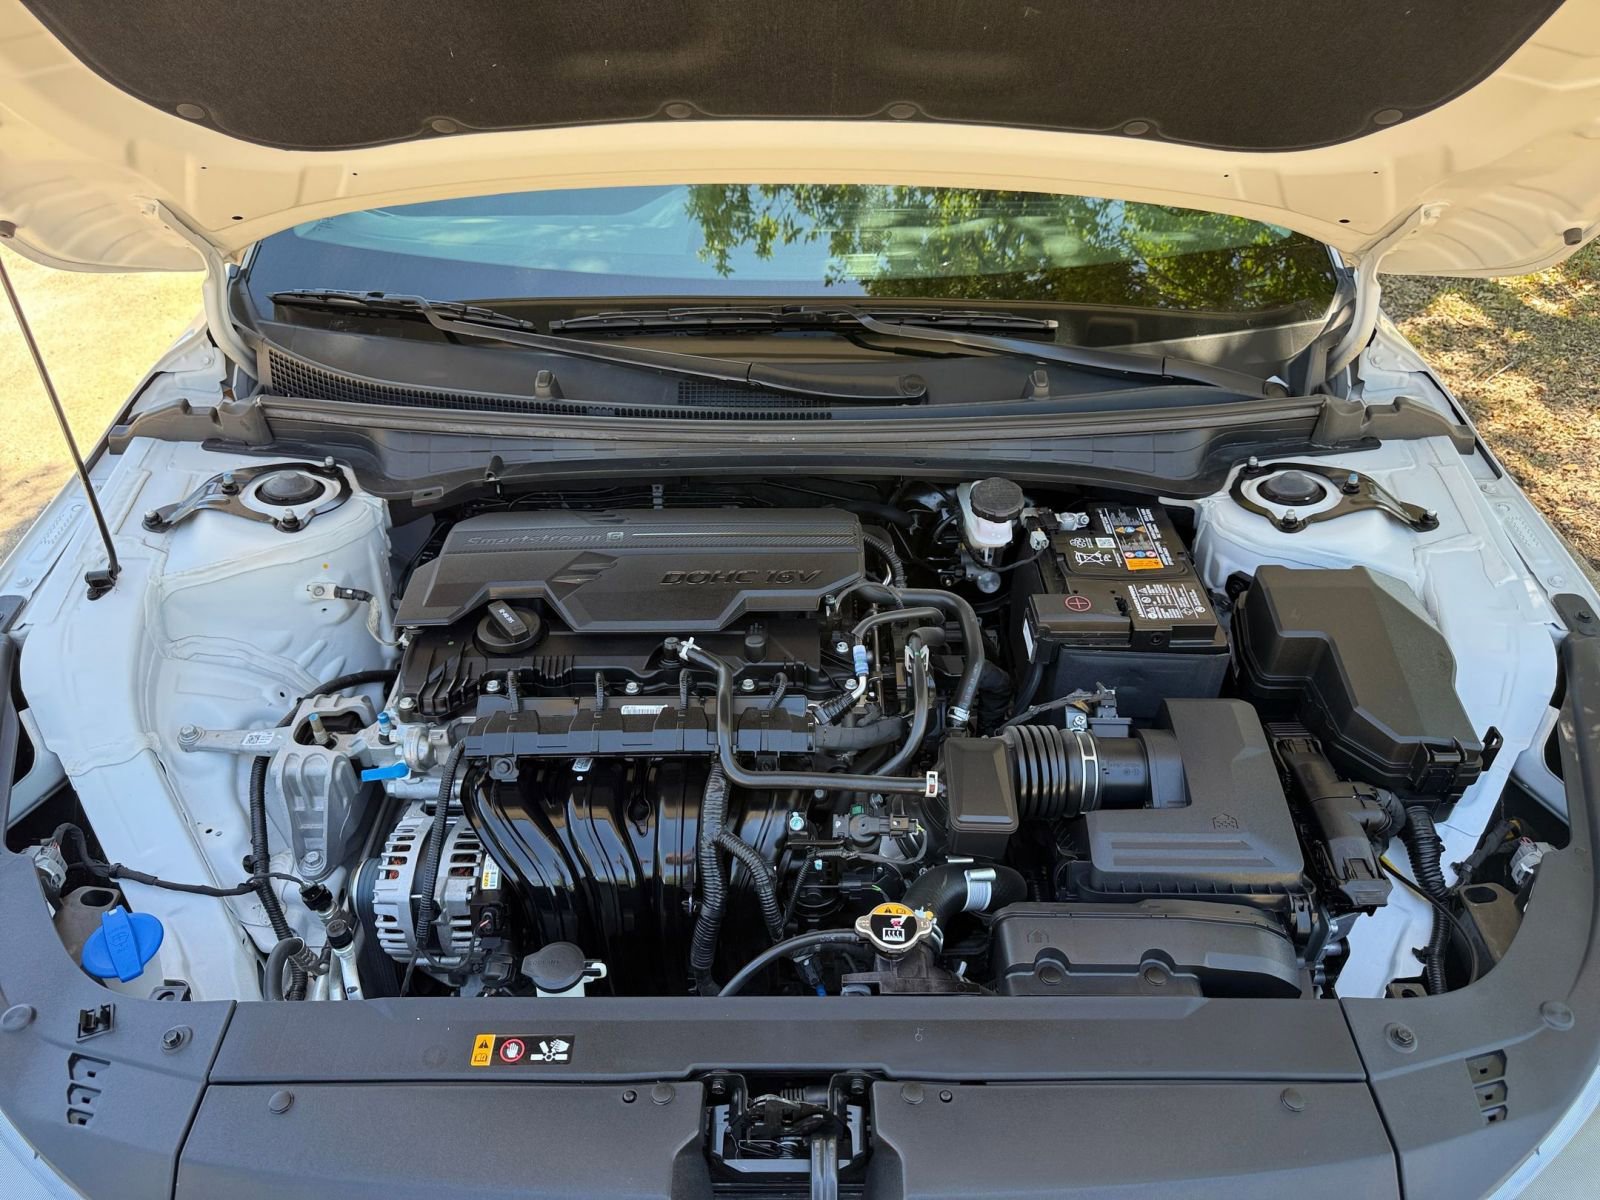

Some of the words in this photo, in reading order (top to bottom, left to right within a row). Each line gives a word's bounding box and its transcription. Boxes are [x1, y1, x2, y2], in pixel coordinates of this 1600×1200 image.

[466, 533, 601, 546] Smartstream
[660, 569, 758, 585] DOHC
[766, 569, 823, 585] 16V
